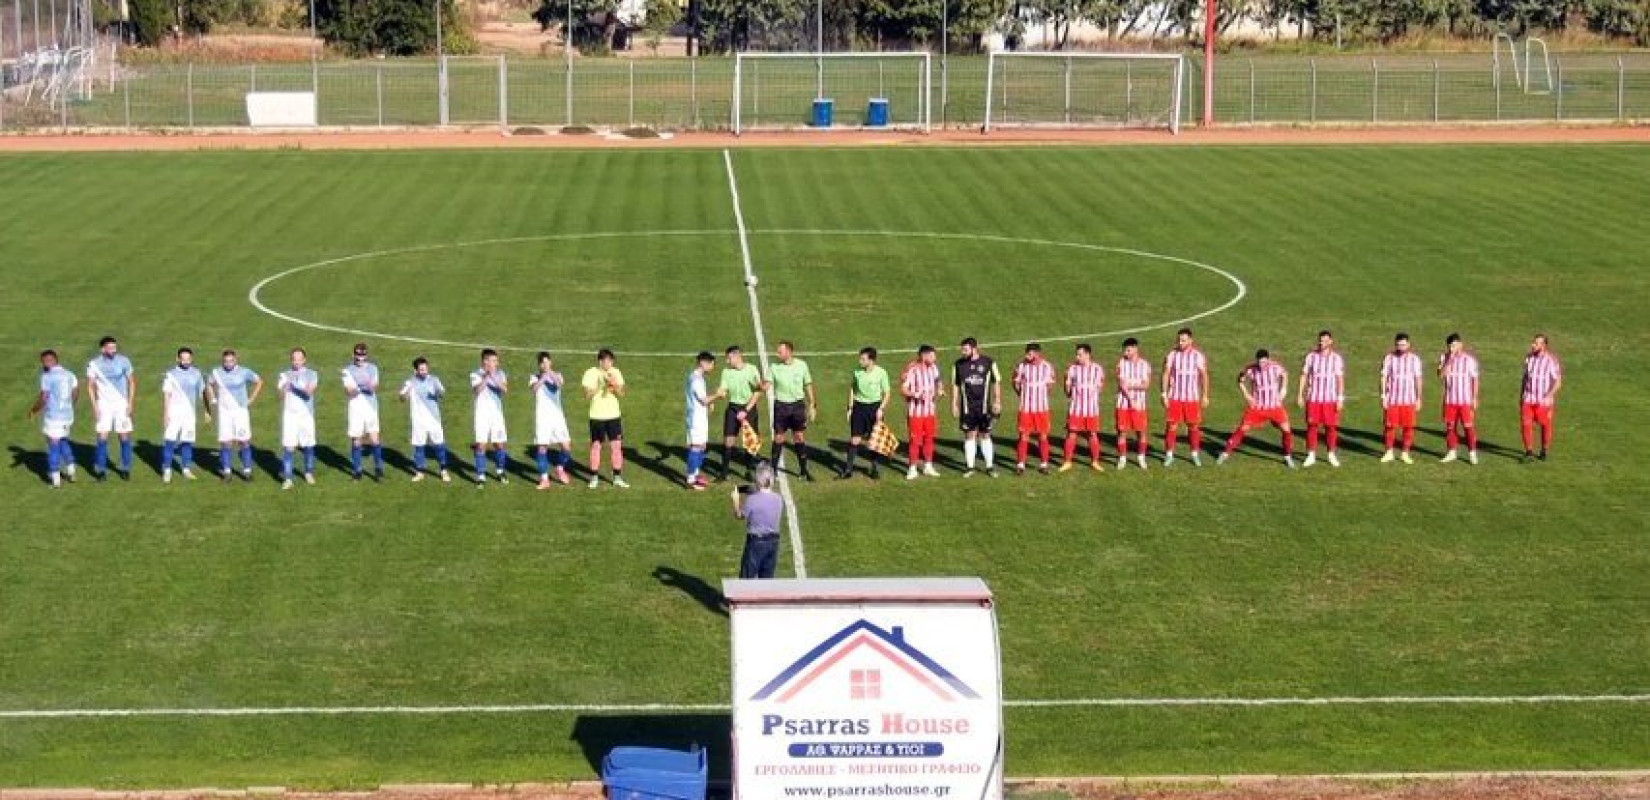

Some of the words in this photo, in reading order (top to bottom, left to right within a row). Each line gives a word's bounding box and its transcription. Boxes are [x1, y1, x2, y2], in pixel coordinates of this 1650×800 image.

[762, 714, 870, 735] Psarras
[881, 714, 970, 735] House
[784, 784, 951, 799] www.psarrashouse.gr
